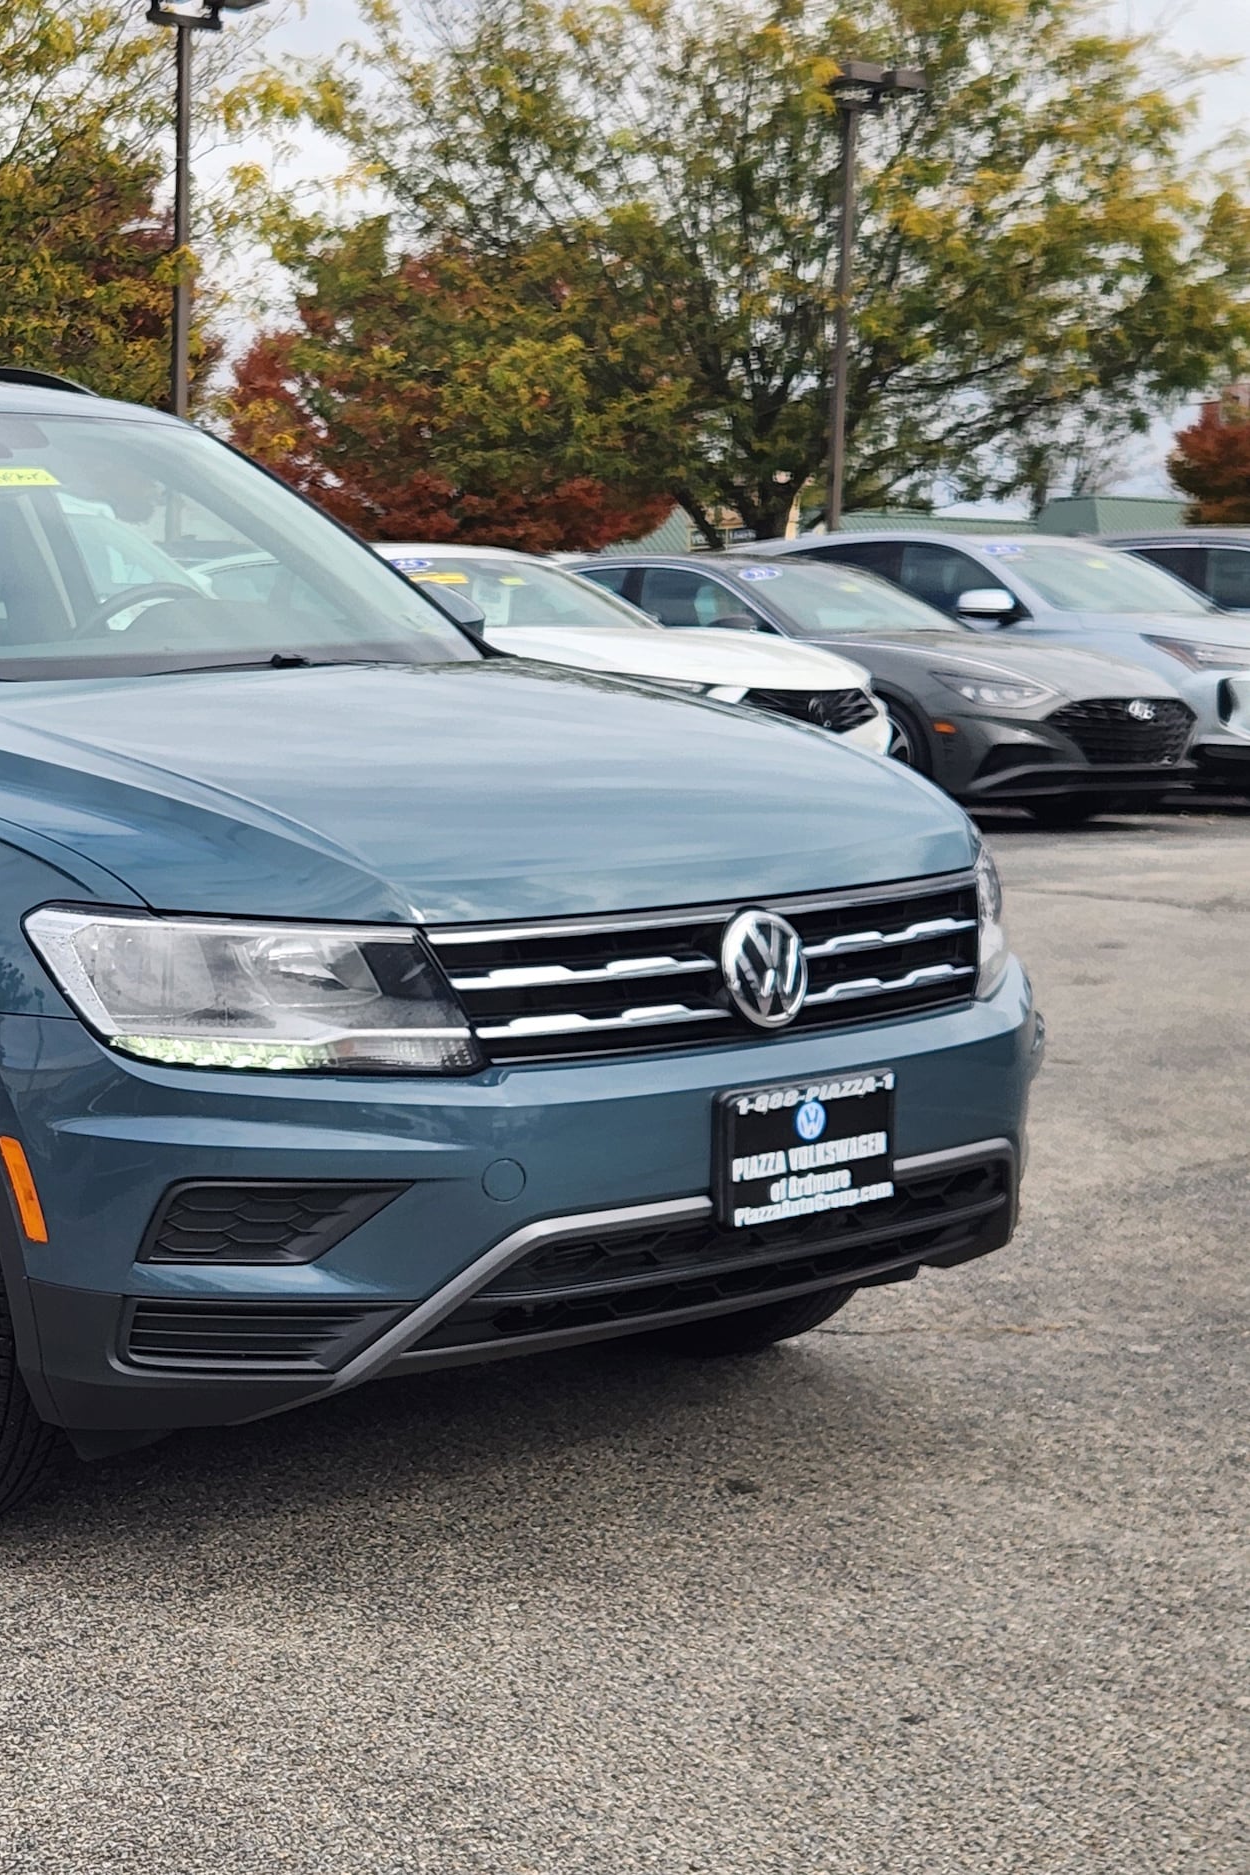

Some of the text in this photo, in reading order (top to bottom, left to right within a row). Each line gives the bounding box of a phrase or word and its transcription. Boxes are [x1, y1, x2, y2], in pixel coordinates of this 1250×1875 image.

[732, 1131, 888, 1182] PIAZZA VOLKSWAGEN
[733, 1181, 895, 1228] PiazzaAutoGroup.com
[770, 1168, 852, 1202] of Ardmore
